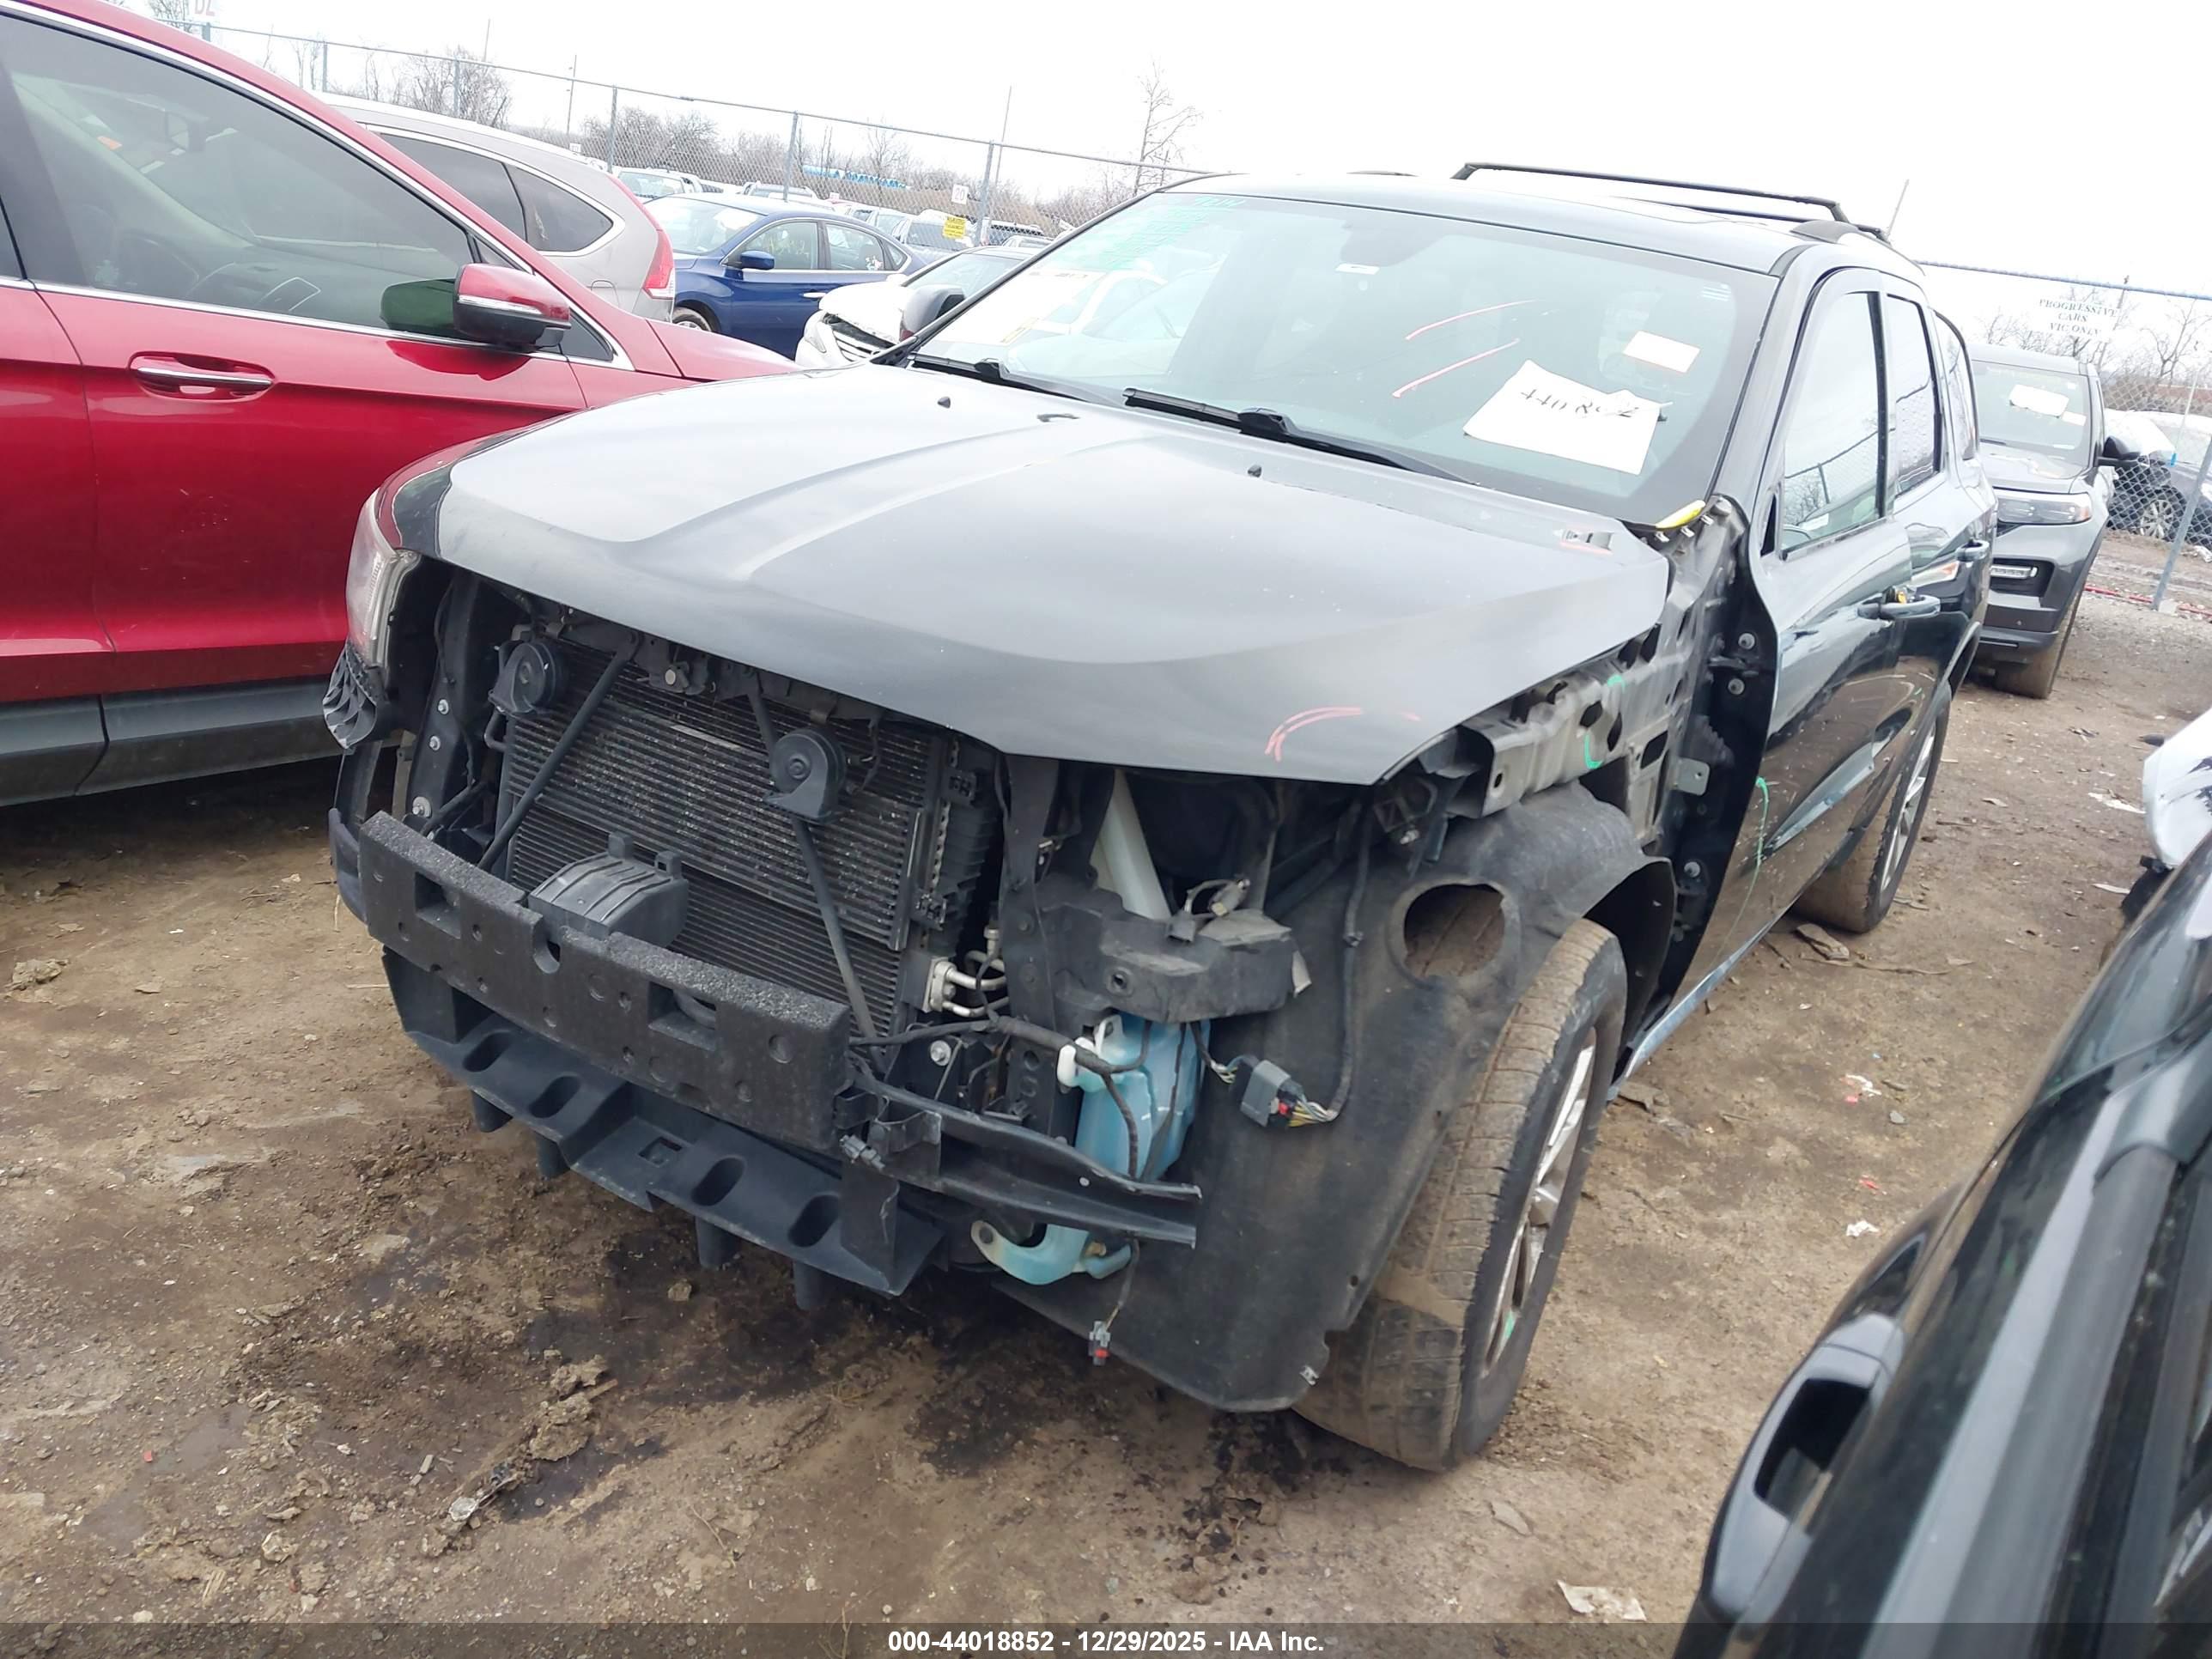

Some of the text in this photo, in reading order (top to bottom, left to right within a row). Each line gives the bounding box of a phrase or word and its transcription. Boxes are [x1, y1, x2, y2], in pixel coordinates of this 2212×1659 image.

[2039, 298, 2118, 318] PROGRESSIVE
[2057, 313, 2088, 323] CARS
[2071, 324, 2101, 336] ONLY
